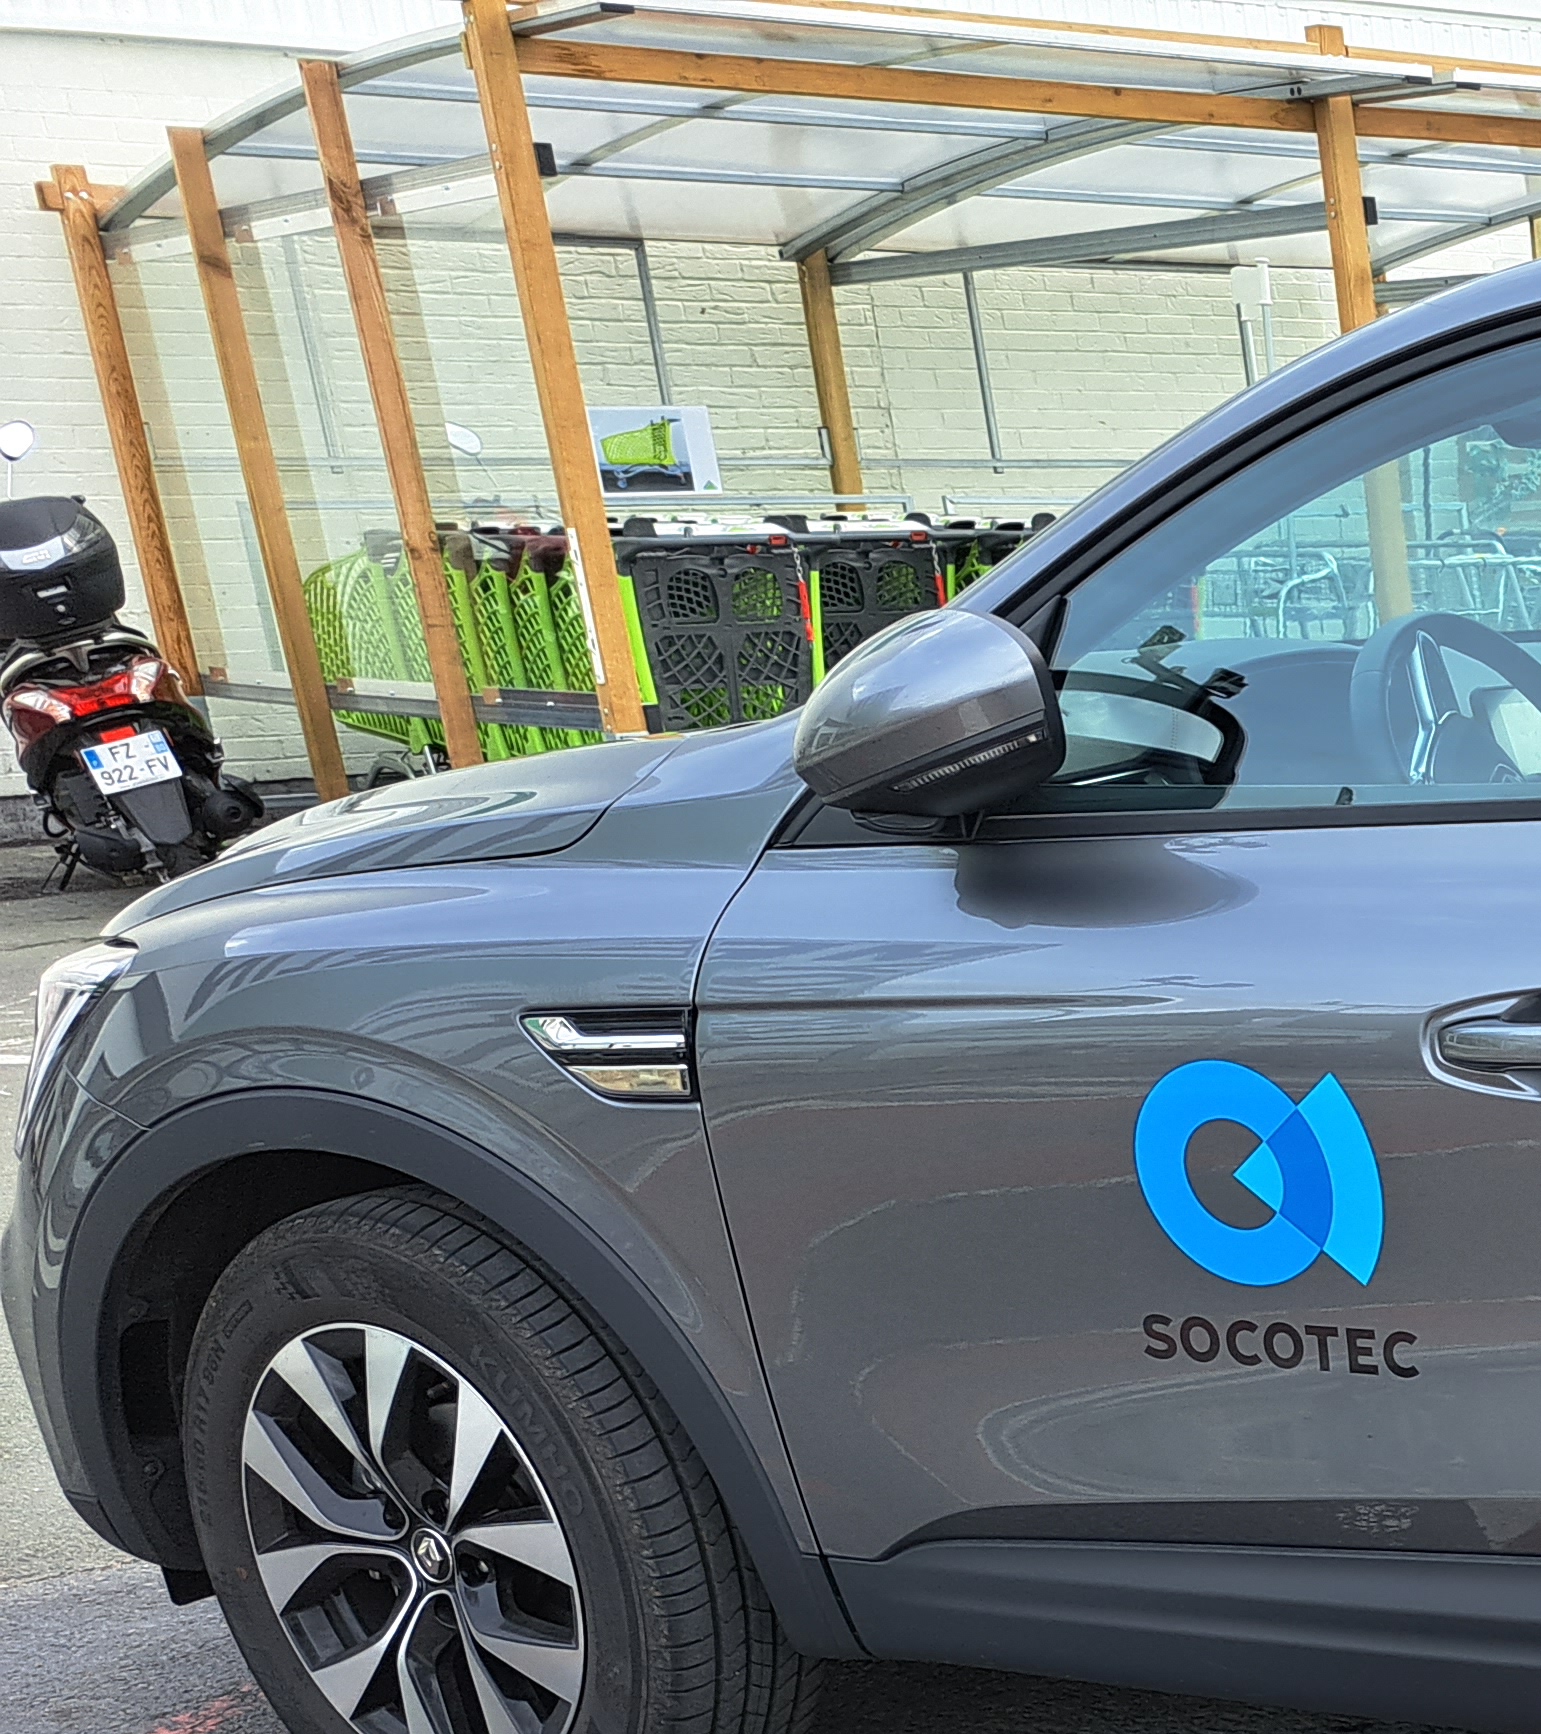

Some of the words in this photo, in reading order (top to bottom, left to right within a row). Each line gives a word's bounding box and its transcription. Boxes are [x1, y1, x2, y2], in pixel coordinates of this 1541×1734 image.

[100, 755, 170, 786] 922-FV
[108, 742, 137, 763] FZ
[1143, 1313, 1420, 1379] SOCOTEC
[469, 1344, 585, 1518] KUMHO
